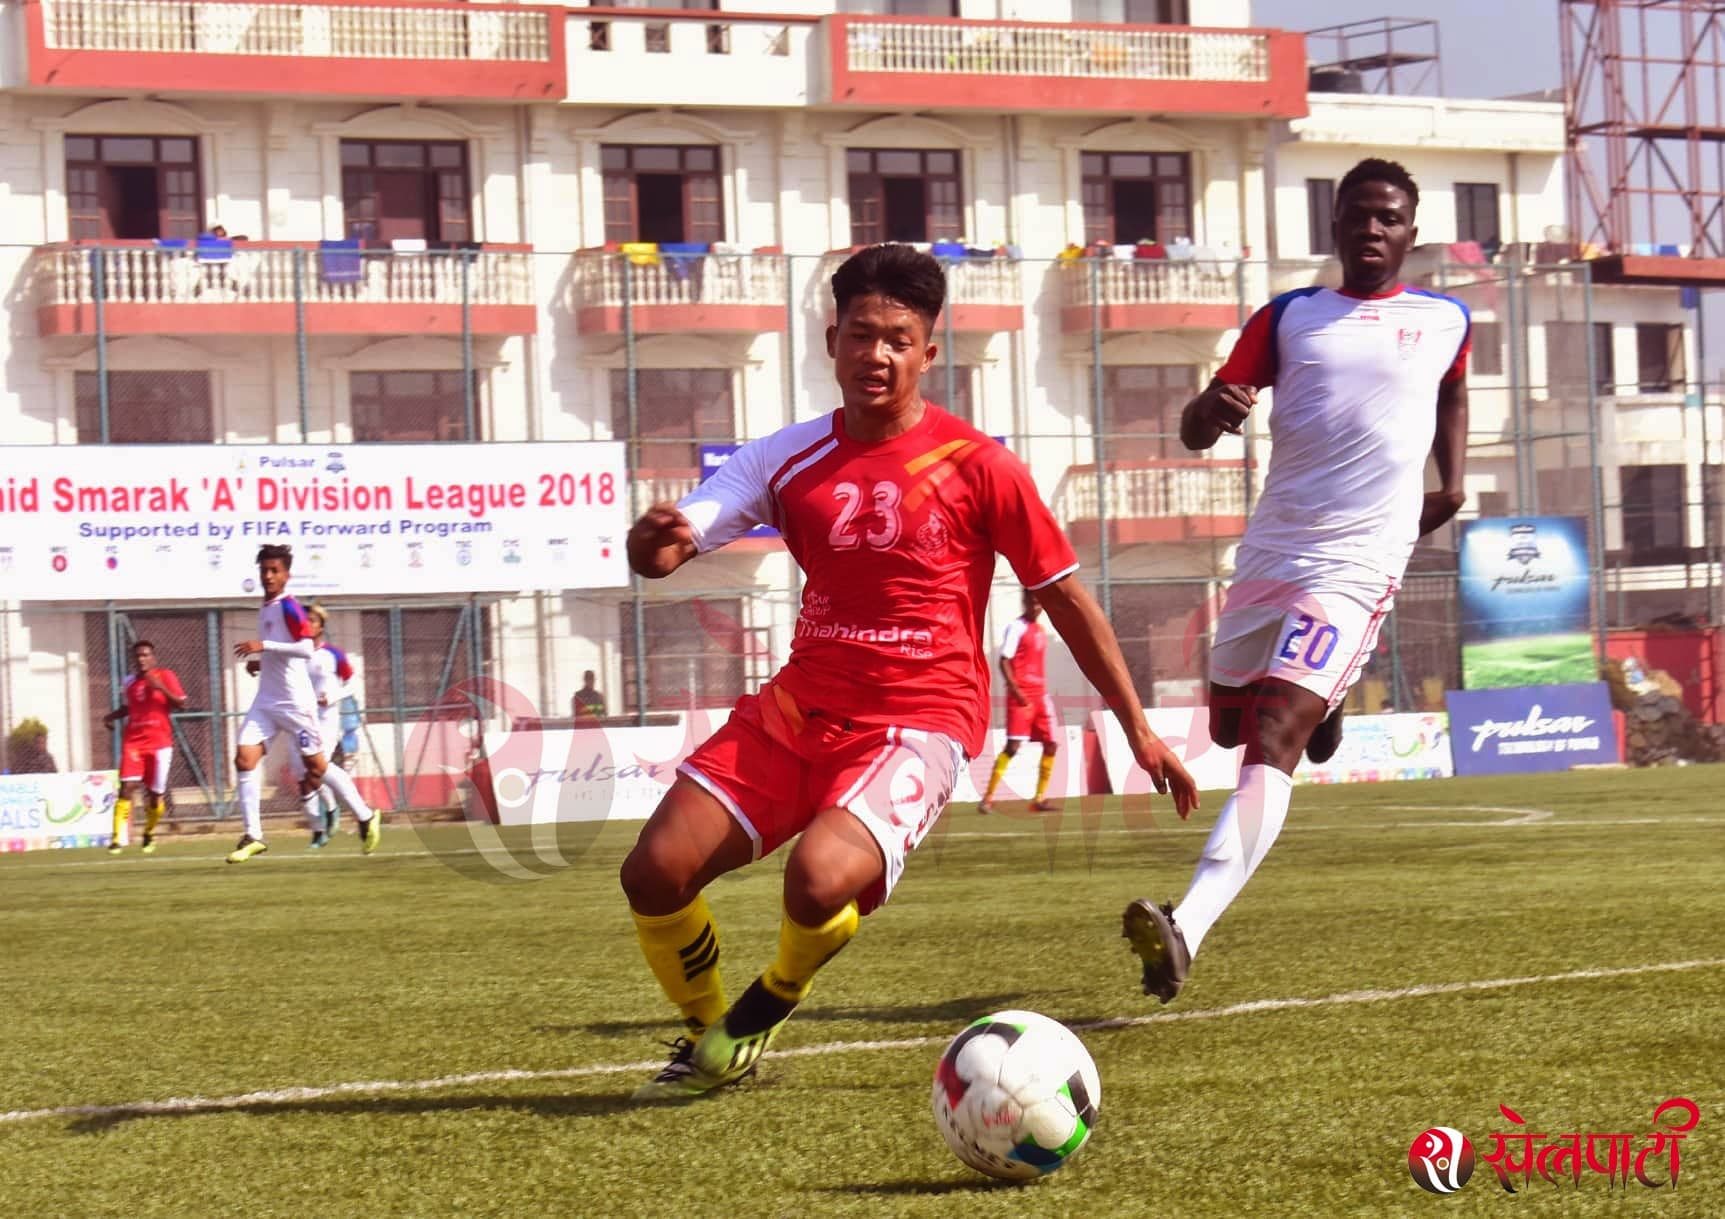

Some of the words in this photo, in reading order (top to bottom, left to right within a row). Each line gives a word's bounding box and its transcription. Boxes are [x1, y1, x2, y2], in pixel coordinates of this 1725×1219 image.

[259, 455, 315, 468] Pulsar
[0, 477, 39, 512] id
[53, 477, 190, 512] Smarak
[203, 477, 243, 511] 'A'
[257, 476, 392, 511] Division
[405, 475, 525, 518] League
[538, 472, 615, 506] 2018
[828, 480, 903, 551] 23
[79, 522, 200, 539] Supported
[208, 521, 234, 539] by
[243, 521, 291, 536] FIFA
[300, 519, 392, 535] Forward
[399, 519, 493, 537] Program
[1279, 613, 1339, 670] 20
[1468, 704, 1596, 753] pulsar
